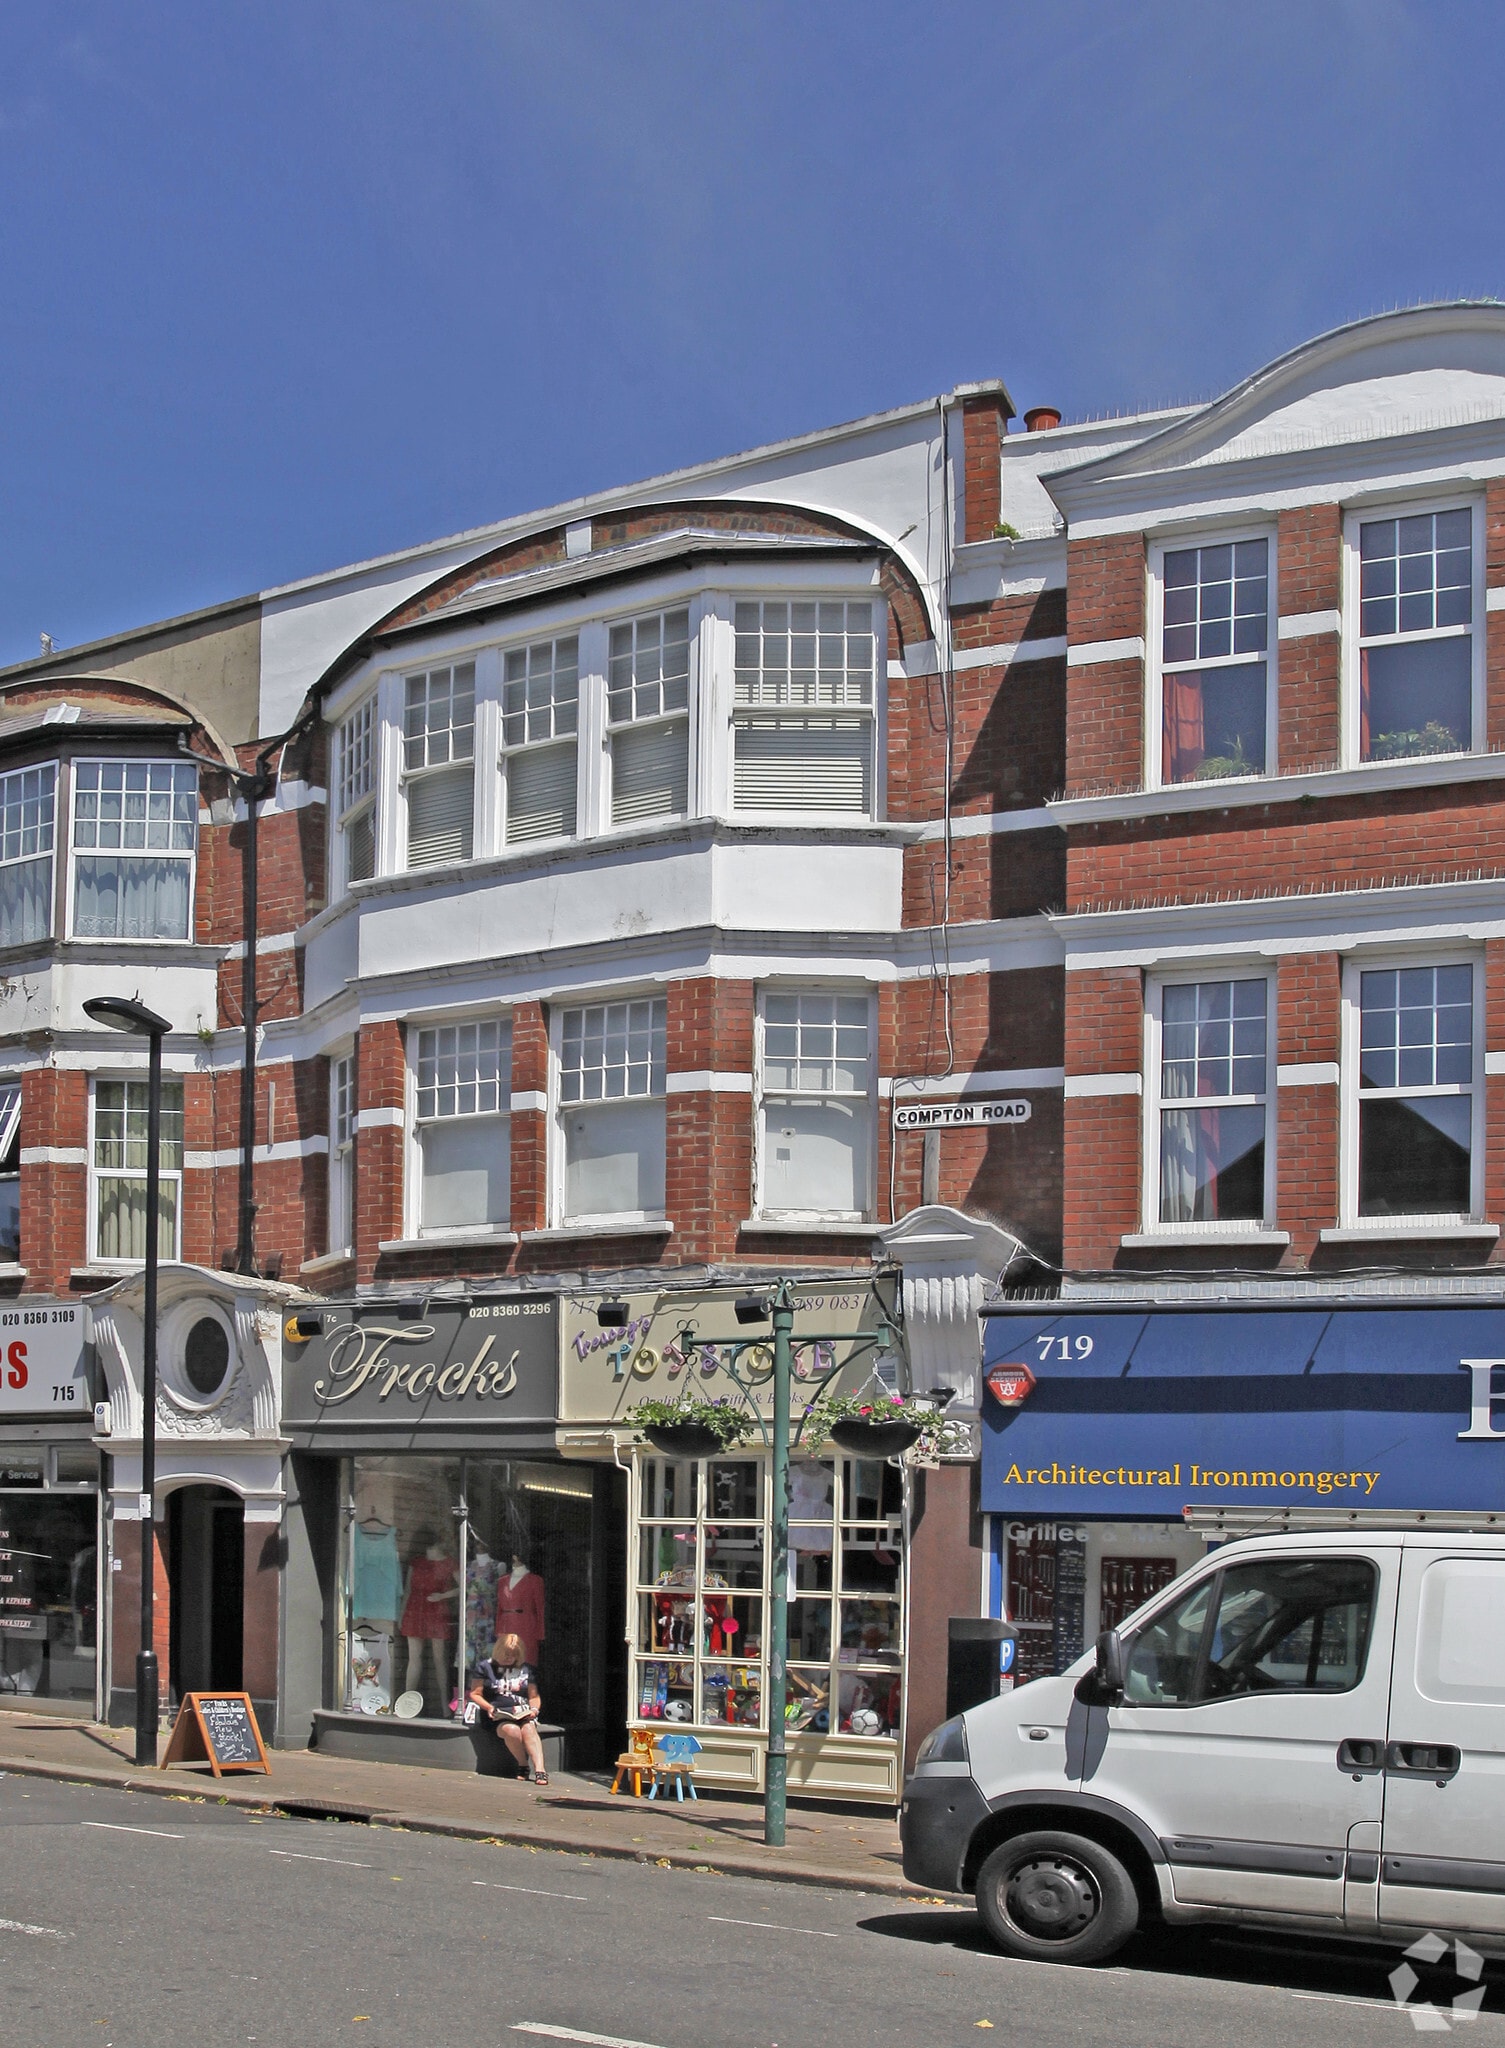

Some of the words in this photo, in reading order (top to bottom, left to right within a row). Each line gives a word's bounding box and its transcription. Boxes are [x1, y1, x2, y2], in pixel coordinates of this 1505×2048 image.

[897, 1107, 974, 1123] COMPTON
[982, 1104, 1026, 1118] ROAD
[2, 1312, 20, 1326] 020
[24, 1311, 48, 1325] 8360
[52, 1310, 75, 1323] 3109
[469, 1307, 490, 1318] 020
[492, 1305, 519, 1317] 8360
[523, 1303, 551, 1315] 3296
[1036, 1335, 1094, 1360] 719
[314, 1323, 520, 1400] Frocks
[52, 1385, 75, 1401] 715
[767, 1392, 804, 1405] Bks
[1003, 1462, 1181, 1486] Architectural
[1190, 1464, 1381, 1494] Ironmongery
[643, 1667, 655, 1703] DIABLO
